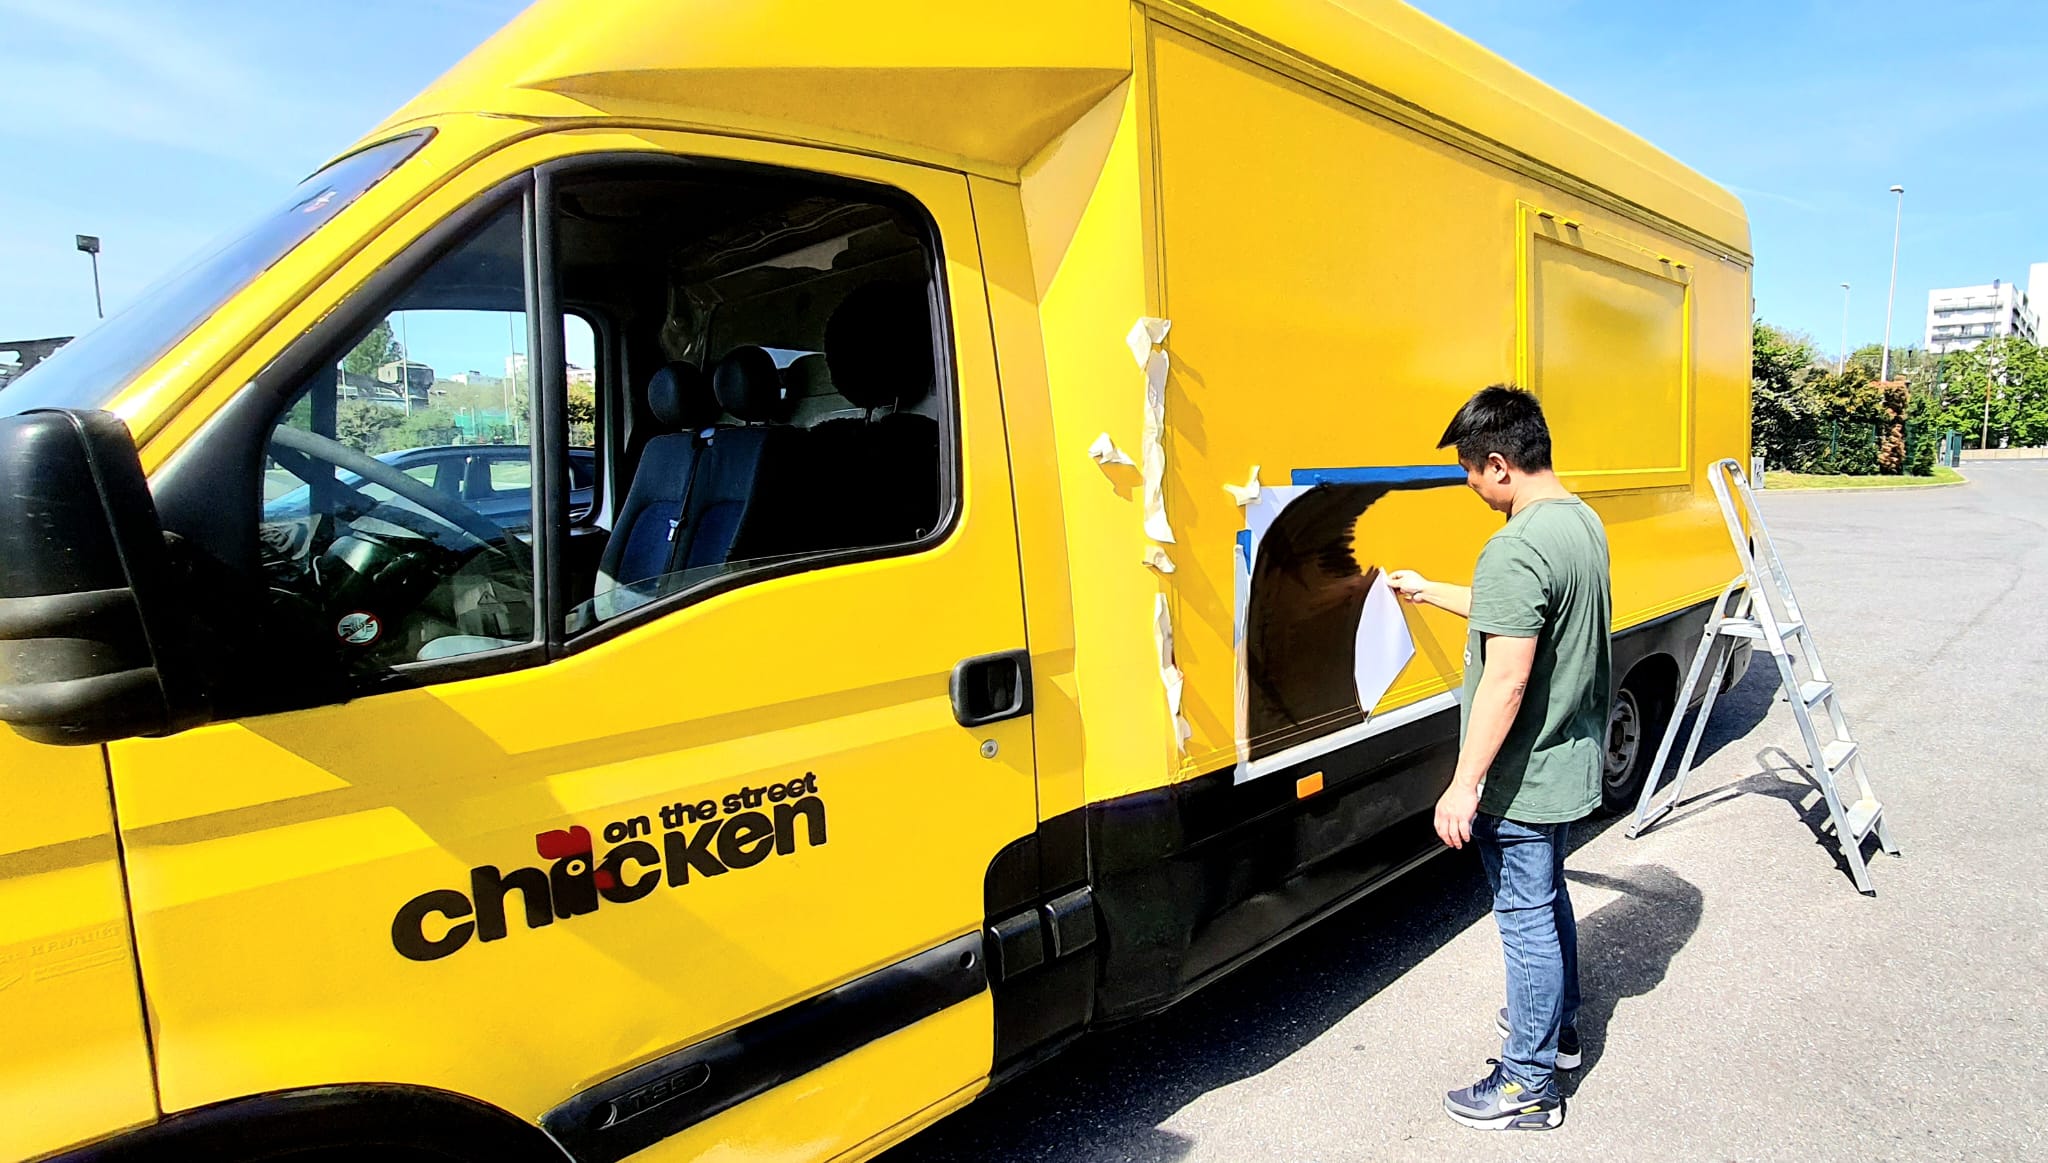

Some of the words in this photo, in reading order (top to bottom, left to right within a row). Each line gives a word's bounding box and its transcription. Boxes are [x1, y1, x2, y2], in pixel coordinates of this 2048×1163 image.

[603, 815, 652, 844] on
[658, 799, 718, 830] the
[722, 771, 818, 815] street
[391, 795, 827, 961] chicken
